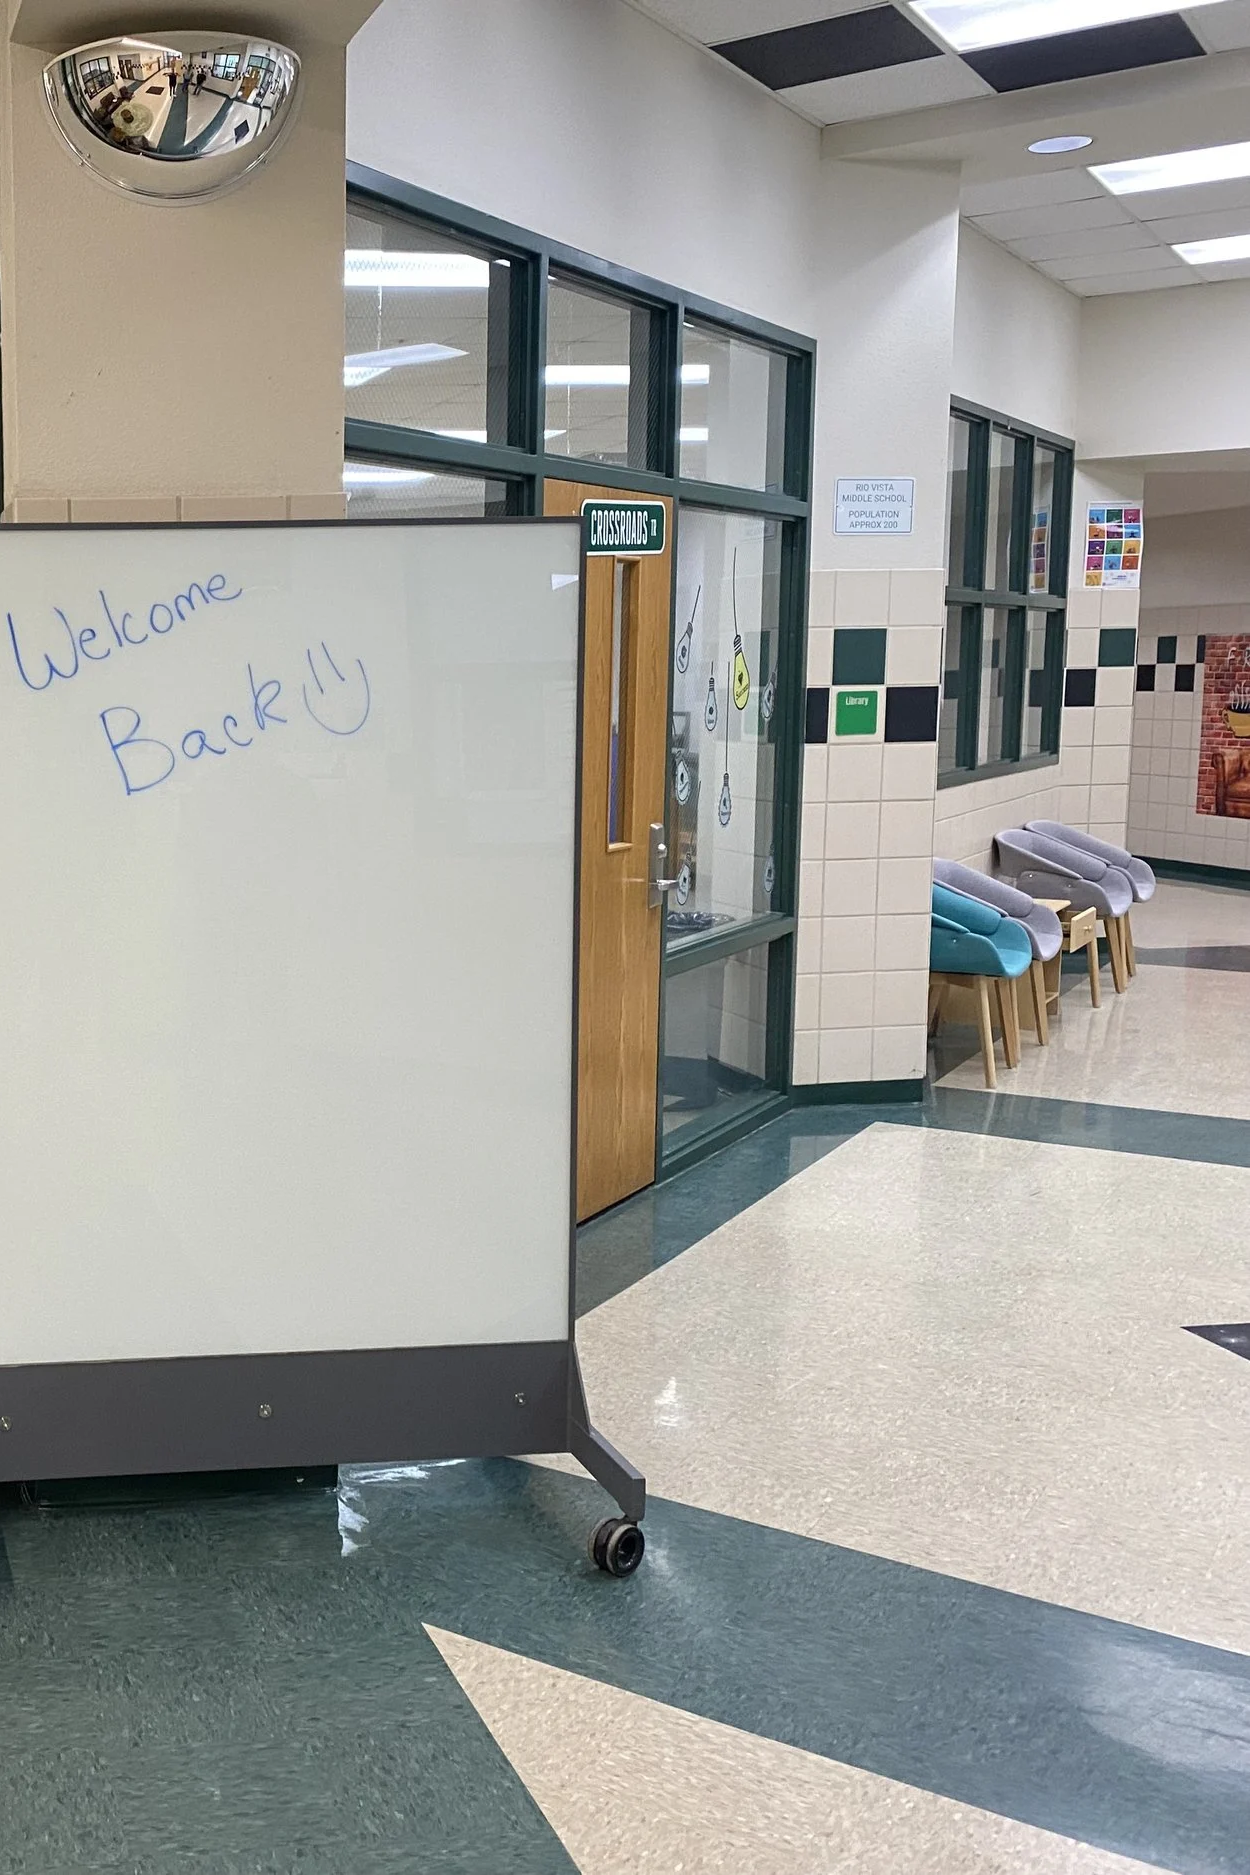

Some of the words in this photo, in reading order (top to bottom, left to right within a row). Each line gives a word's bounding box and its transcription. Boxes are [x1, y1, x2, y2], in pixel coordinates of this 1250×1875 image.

[855, 483, 870, 492] RIO
[871, 483, 895, 492] VISTA
[842, 494, 873, 503] MIDDLE
[874, 494, 907, 503] SCHOOL
[848, 510, 900, 519] POPULATION
[590, 509, 649, 546] CROSSROADS
[849, 520, 882, 529] APPROX
[883, 520, 898, 529] 200
[6, 571, 244, 691] Welcome
[845, 695, 869, 706] Library
[99, 662, 288, 796] Back
